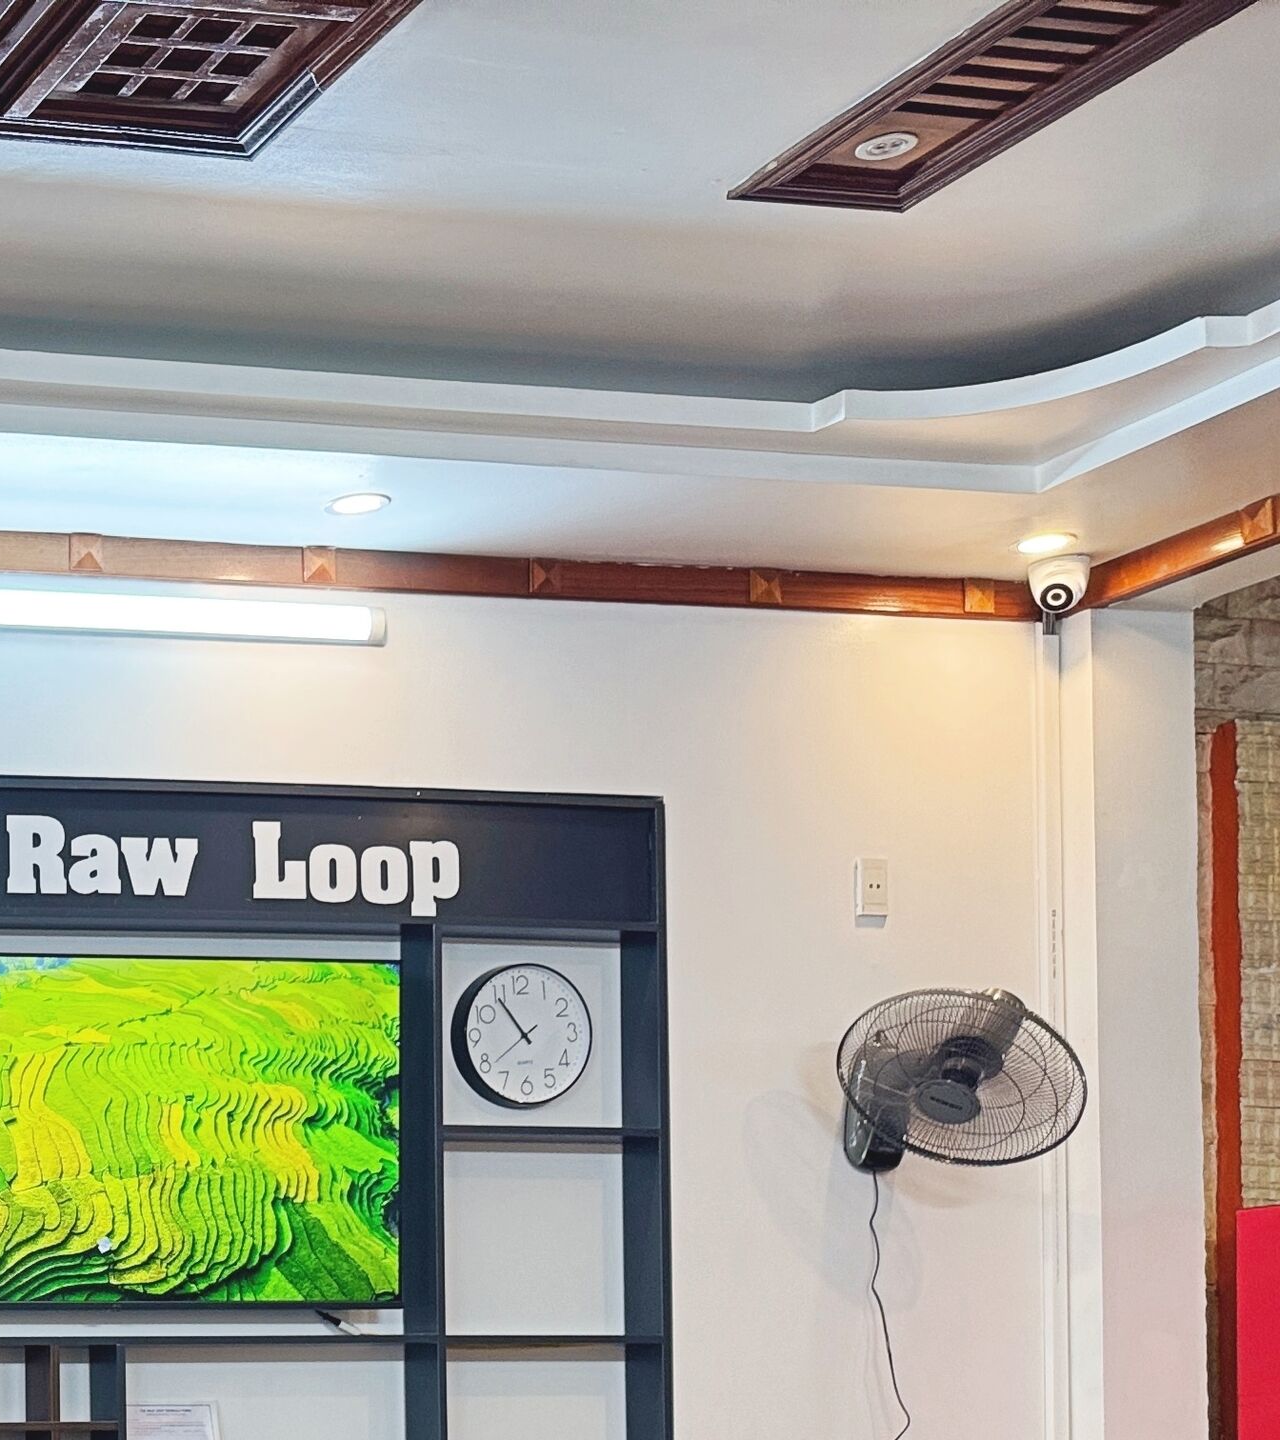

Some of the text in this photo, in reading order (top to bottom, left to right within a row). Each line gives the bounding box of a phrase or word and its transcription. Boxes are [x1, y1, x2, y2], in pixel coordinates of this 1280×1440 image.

[5, 814, 199, 896] Raw
[251, 821, 461, 917] Loop
[512, 975, 530, 995] 12
[541, 980, 546, 1000] 1
[475, 1004, 496, 1024] 10
[555, 997, 569, 1017] 2
[468, 1028, 481, 1048] 9
[566, 1022, 578, 1042] 3
[479, 1053, 491, 1073] 8
[558, 1048, 570, 1067] 4
[498, 1070, 509, 1090] 7
[520, 1075, 534, 1095] 6
[544, 1068, 556, 1088] 5
